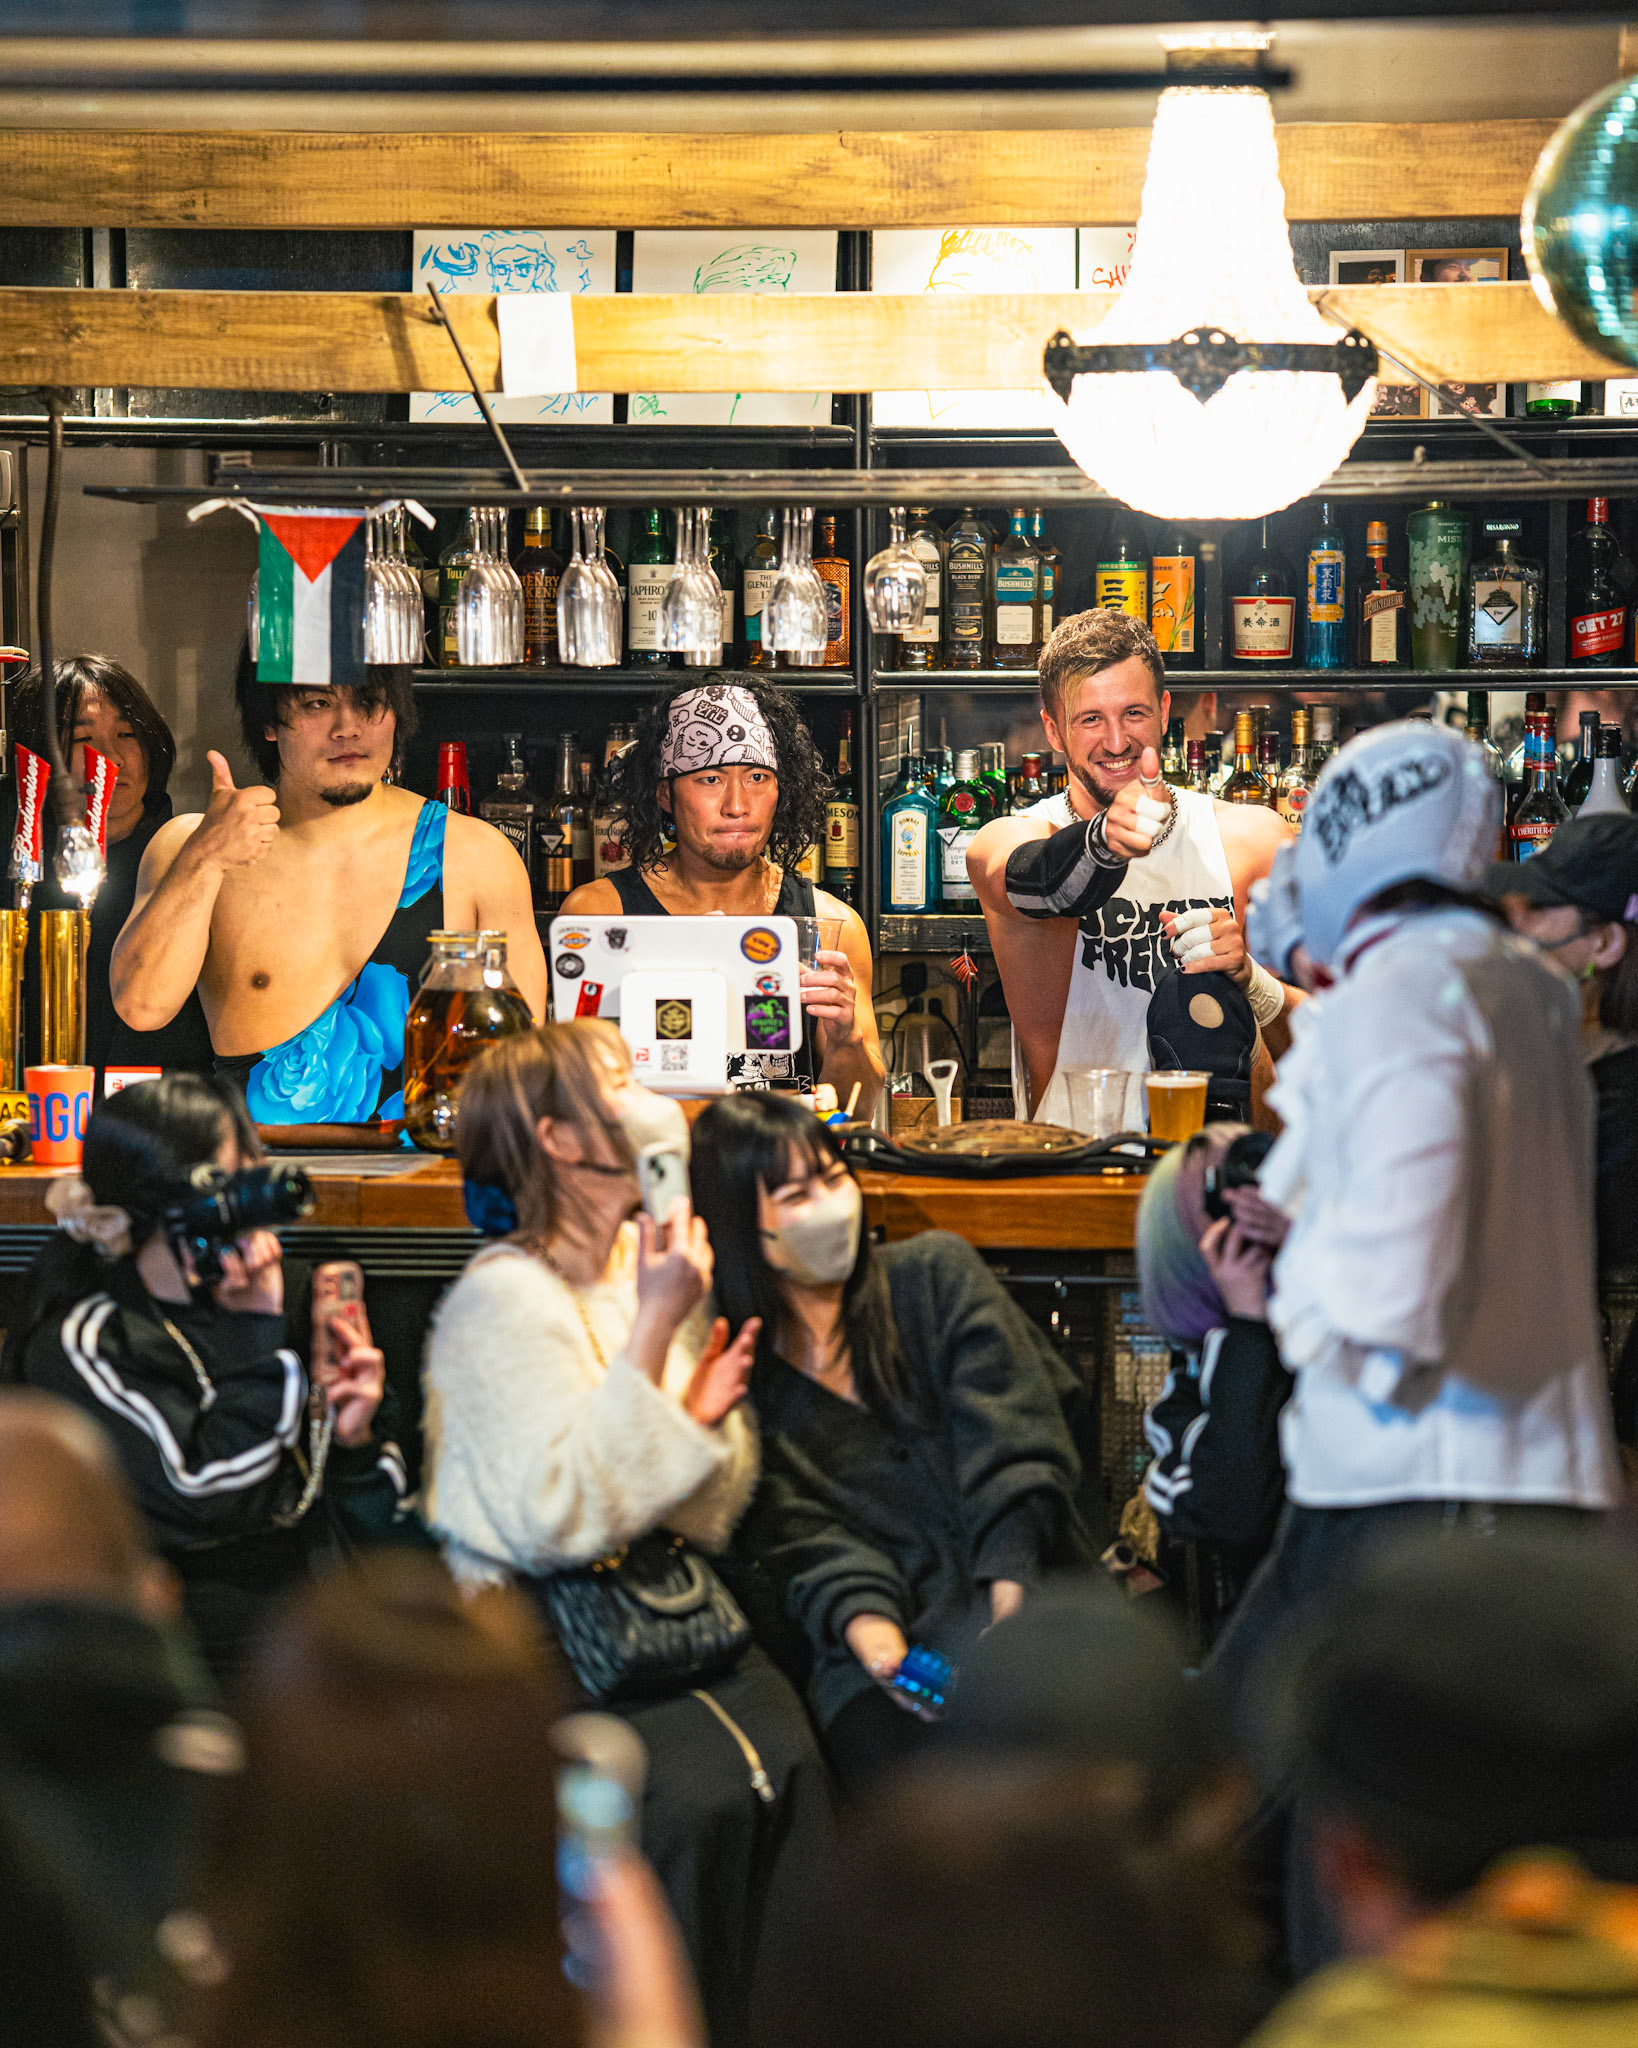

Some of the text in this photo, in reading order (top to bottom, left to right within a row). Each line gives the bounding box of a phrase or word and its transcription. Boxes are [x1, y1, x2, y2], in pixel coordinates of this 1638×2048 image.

[949, 562, 984, 570] BUSHMILLS
[997, 580, 1033, 588] BUSHMILLS
[1321, 567, 1334, 600] 茉莉花
[1367, 594, 1403, 615] COINTREAU
[1242, 616, 1280, 628] 養命酒
[1576, 612, 1624, 634] GET 27
[14, 754, 39, 861] Budweiser
[87, 755, 107, 845] udweiser
